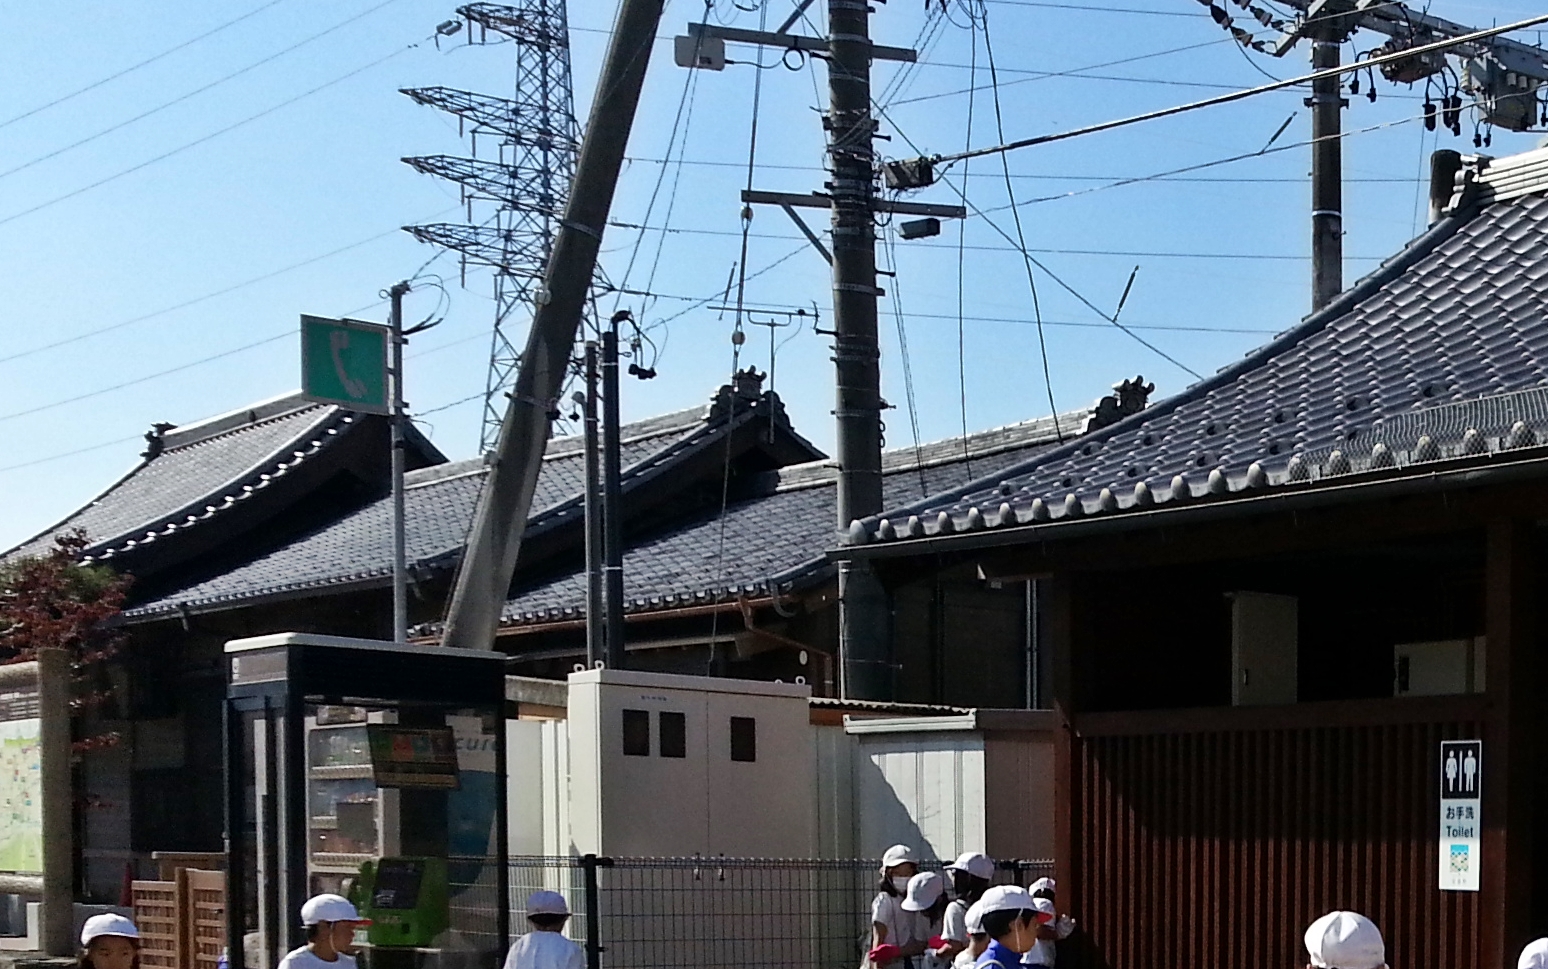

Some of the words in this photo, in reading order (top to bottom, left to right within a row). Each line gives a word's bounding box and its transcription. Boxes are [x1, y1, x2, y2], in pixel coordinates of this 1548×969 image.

[1446, 806, 1474, 820] お手洗
[1446, 825, 1474, 838] Toilet
